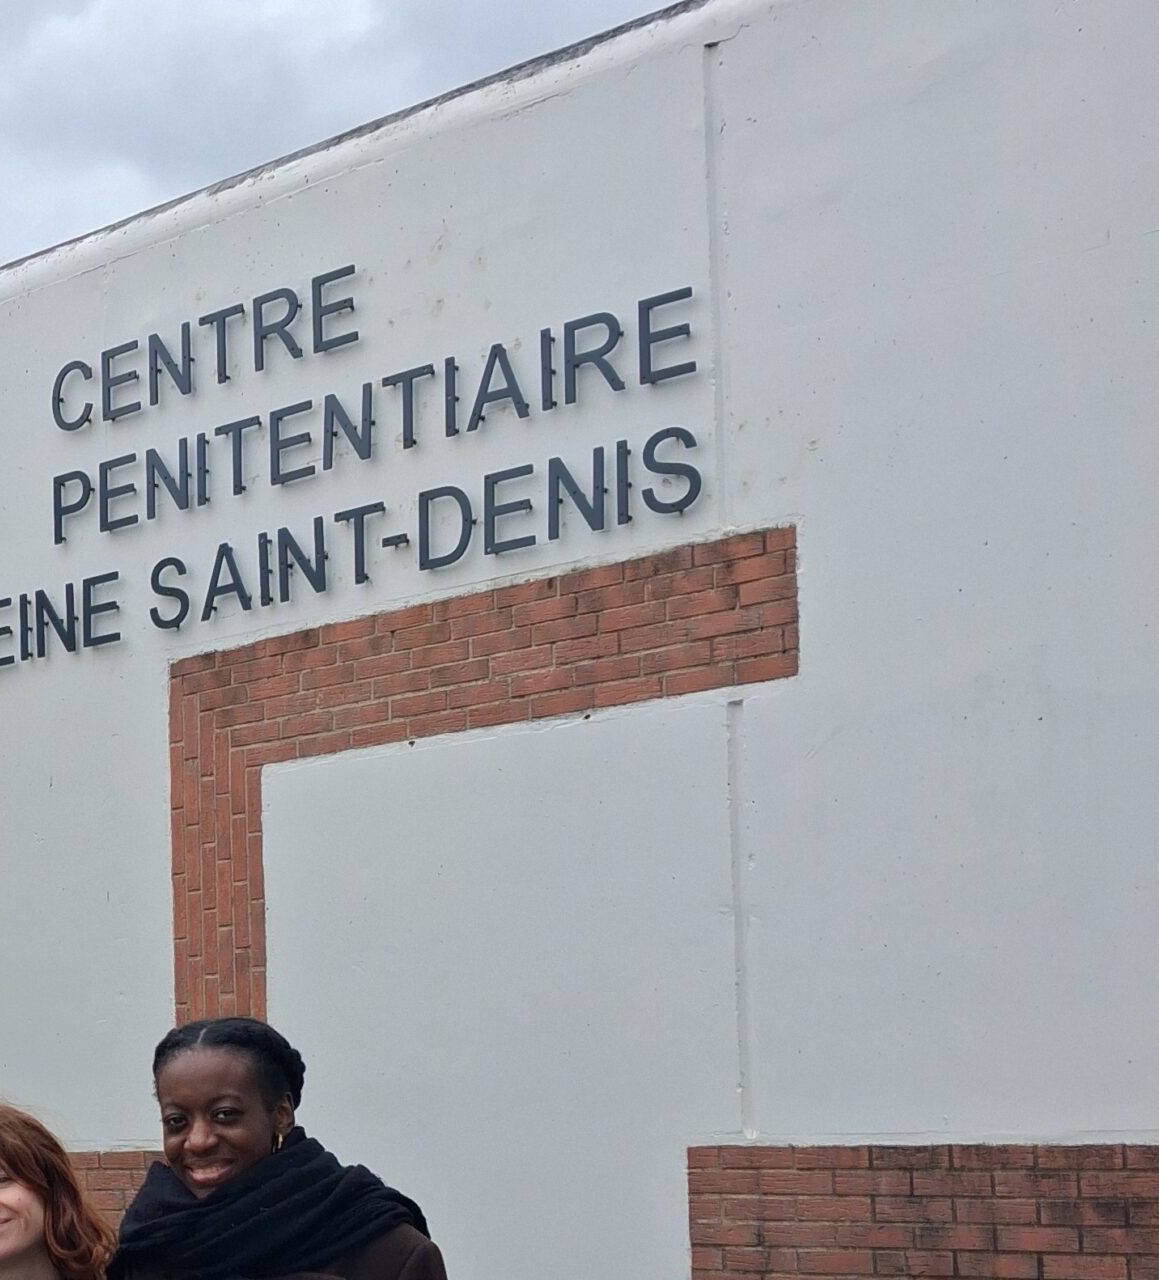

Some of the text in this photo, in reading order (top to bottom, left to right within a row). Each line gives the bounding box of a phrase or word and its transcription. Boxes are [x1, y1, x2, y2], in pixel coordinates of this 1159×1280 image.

[52, 264, 359, 431] CENTRE
[53, 286, 696, 545] PENITENTIAIRE
[149, 427, 702, 630] SAINT-DENIS
